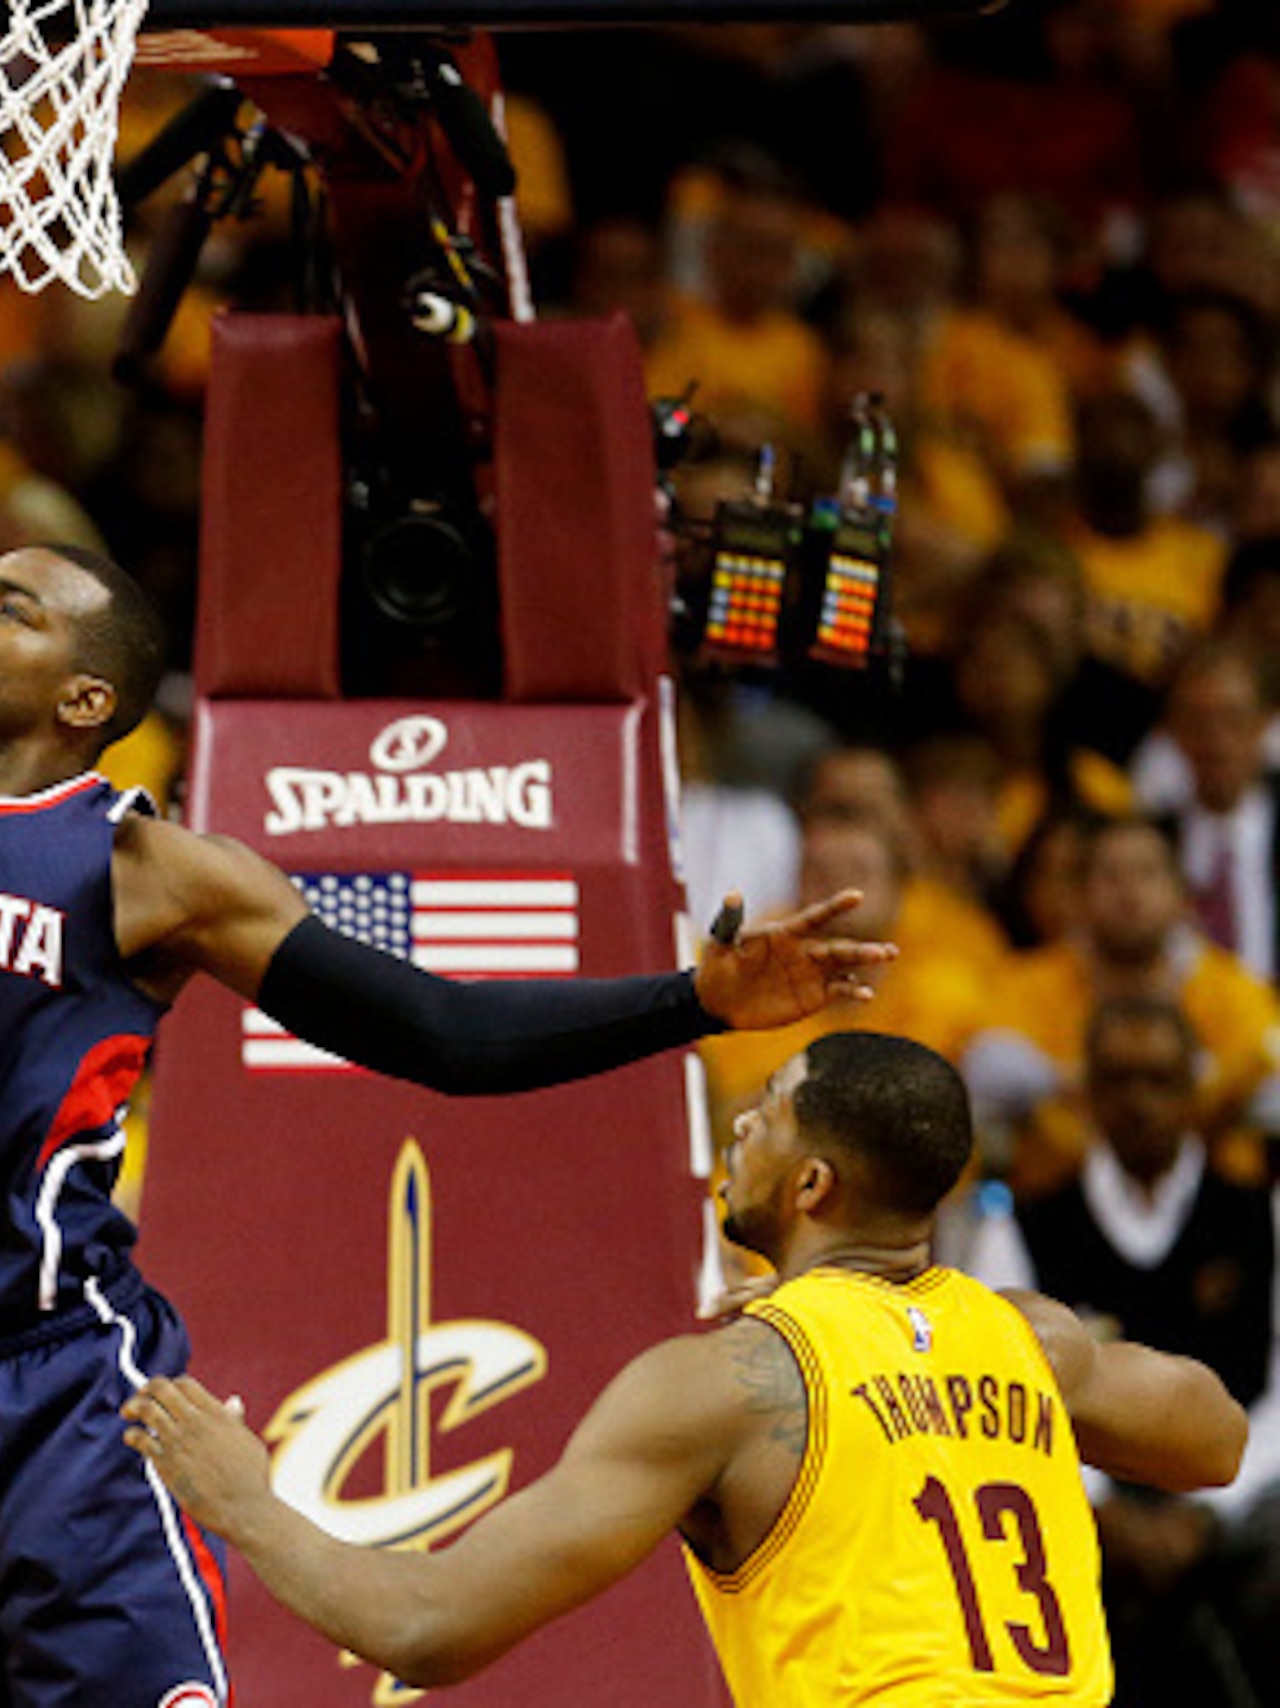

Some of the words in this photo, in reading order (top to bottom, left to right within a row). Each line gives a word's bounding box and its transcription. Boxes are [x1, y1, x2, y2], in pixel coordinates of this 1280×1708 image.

[265, 759, 552, 835] SPALDING
[849, 1373, 1054, 1457] THOMPSON
[911, 1475, 1071, 1677] 13
